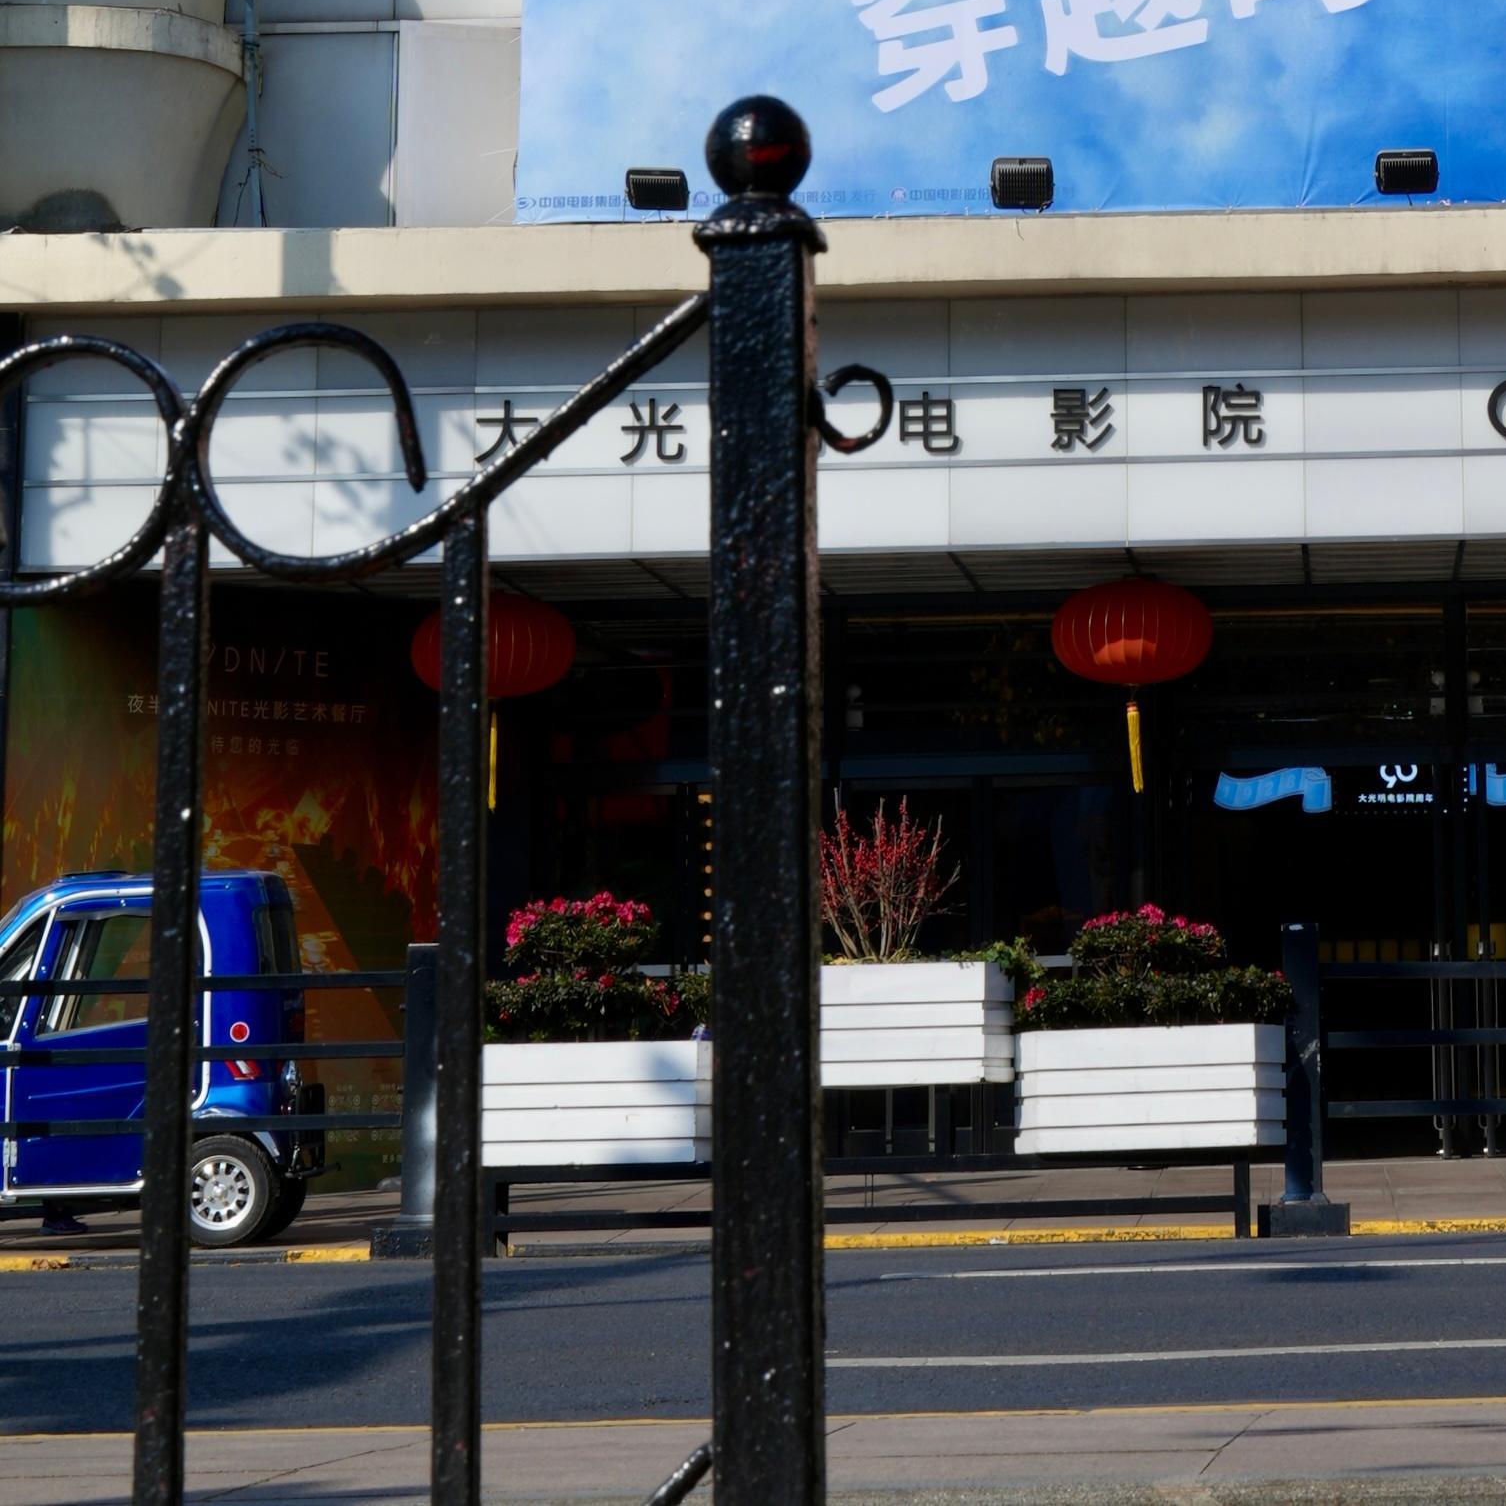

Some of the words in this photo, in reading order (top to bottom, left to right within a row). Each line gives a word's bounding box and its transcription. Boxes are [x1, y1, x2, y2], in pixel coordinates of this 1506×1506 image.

[538, 194, 629, 209] 中国电影集团
[475, 383, 1268, 466] 大光电影院
